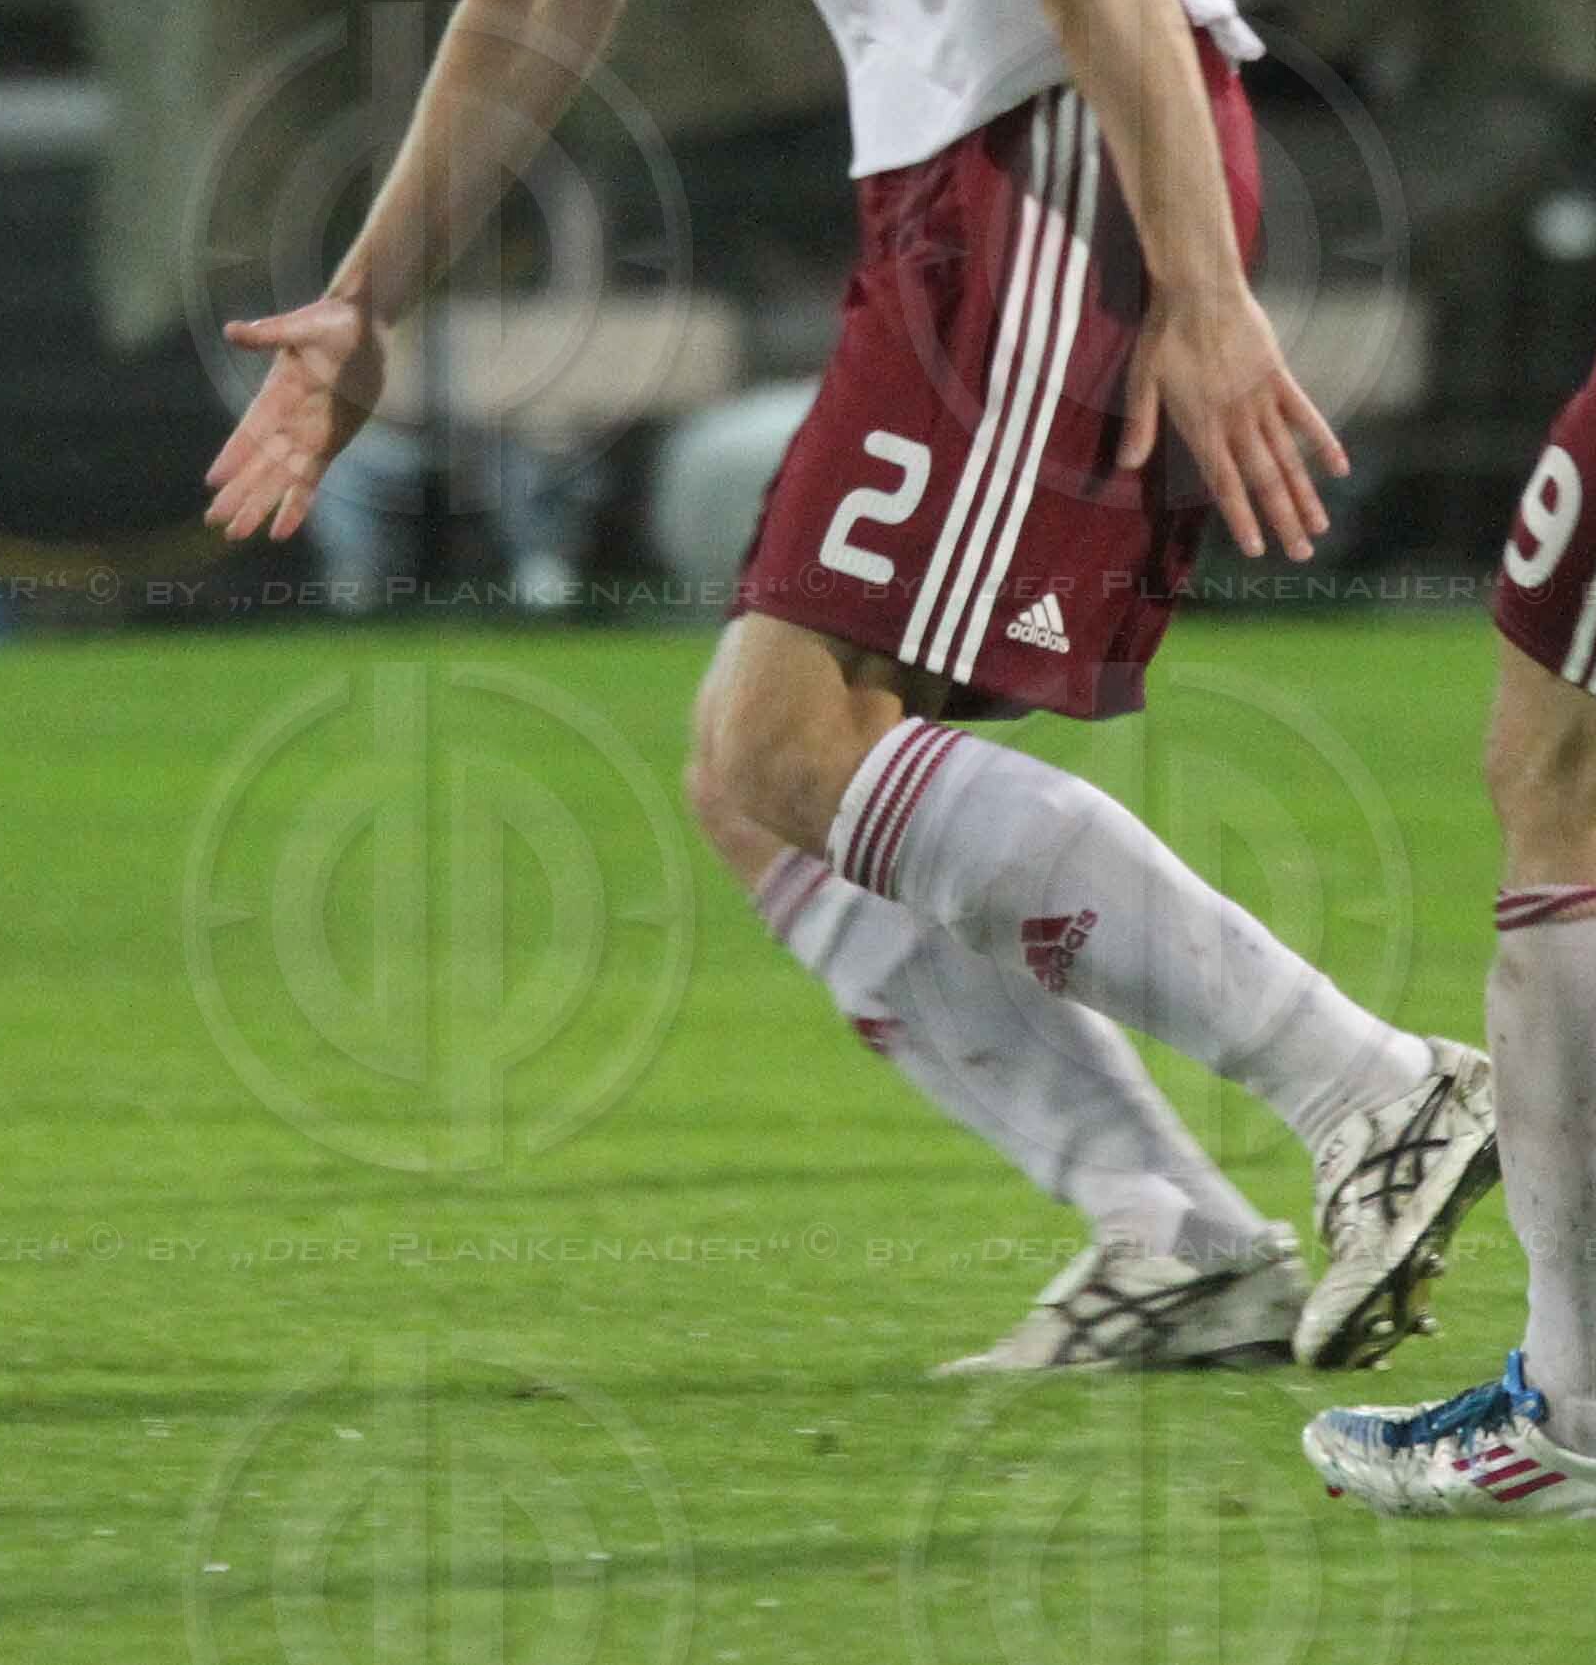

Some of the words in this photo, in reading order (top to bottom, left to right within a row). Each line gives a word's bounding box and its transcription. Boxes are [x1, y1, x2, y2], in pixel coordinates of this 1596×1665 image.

[818, 430, 932, 586] 2
[1505, 445, 1582, 587] 9
[1006, 622, 1071, 654] adidas
